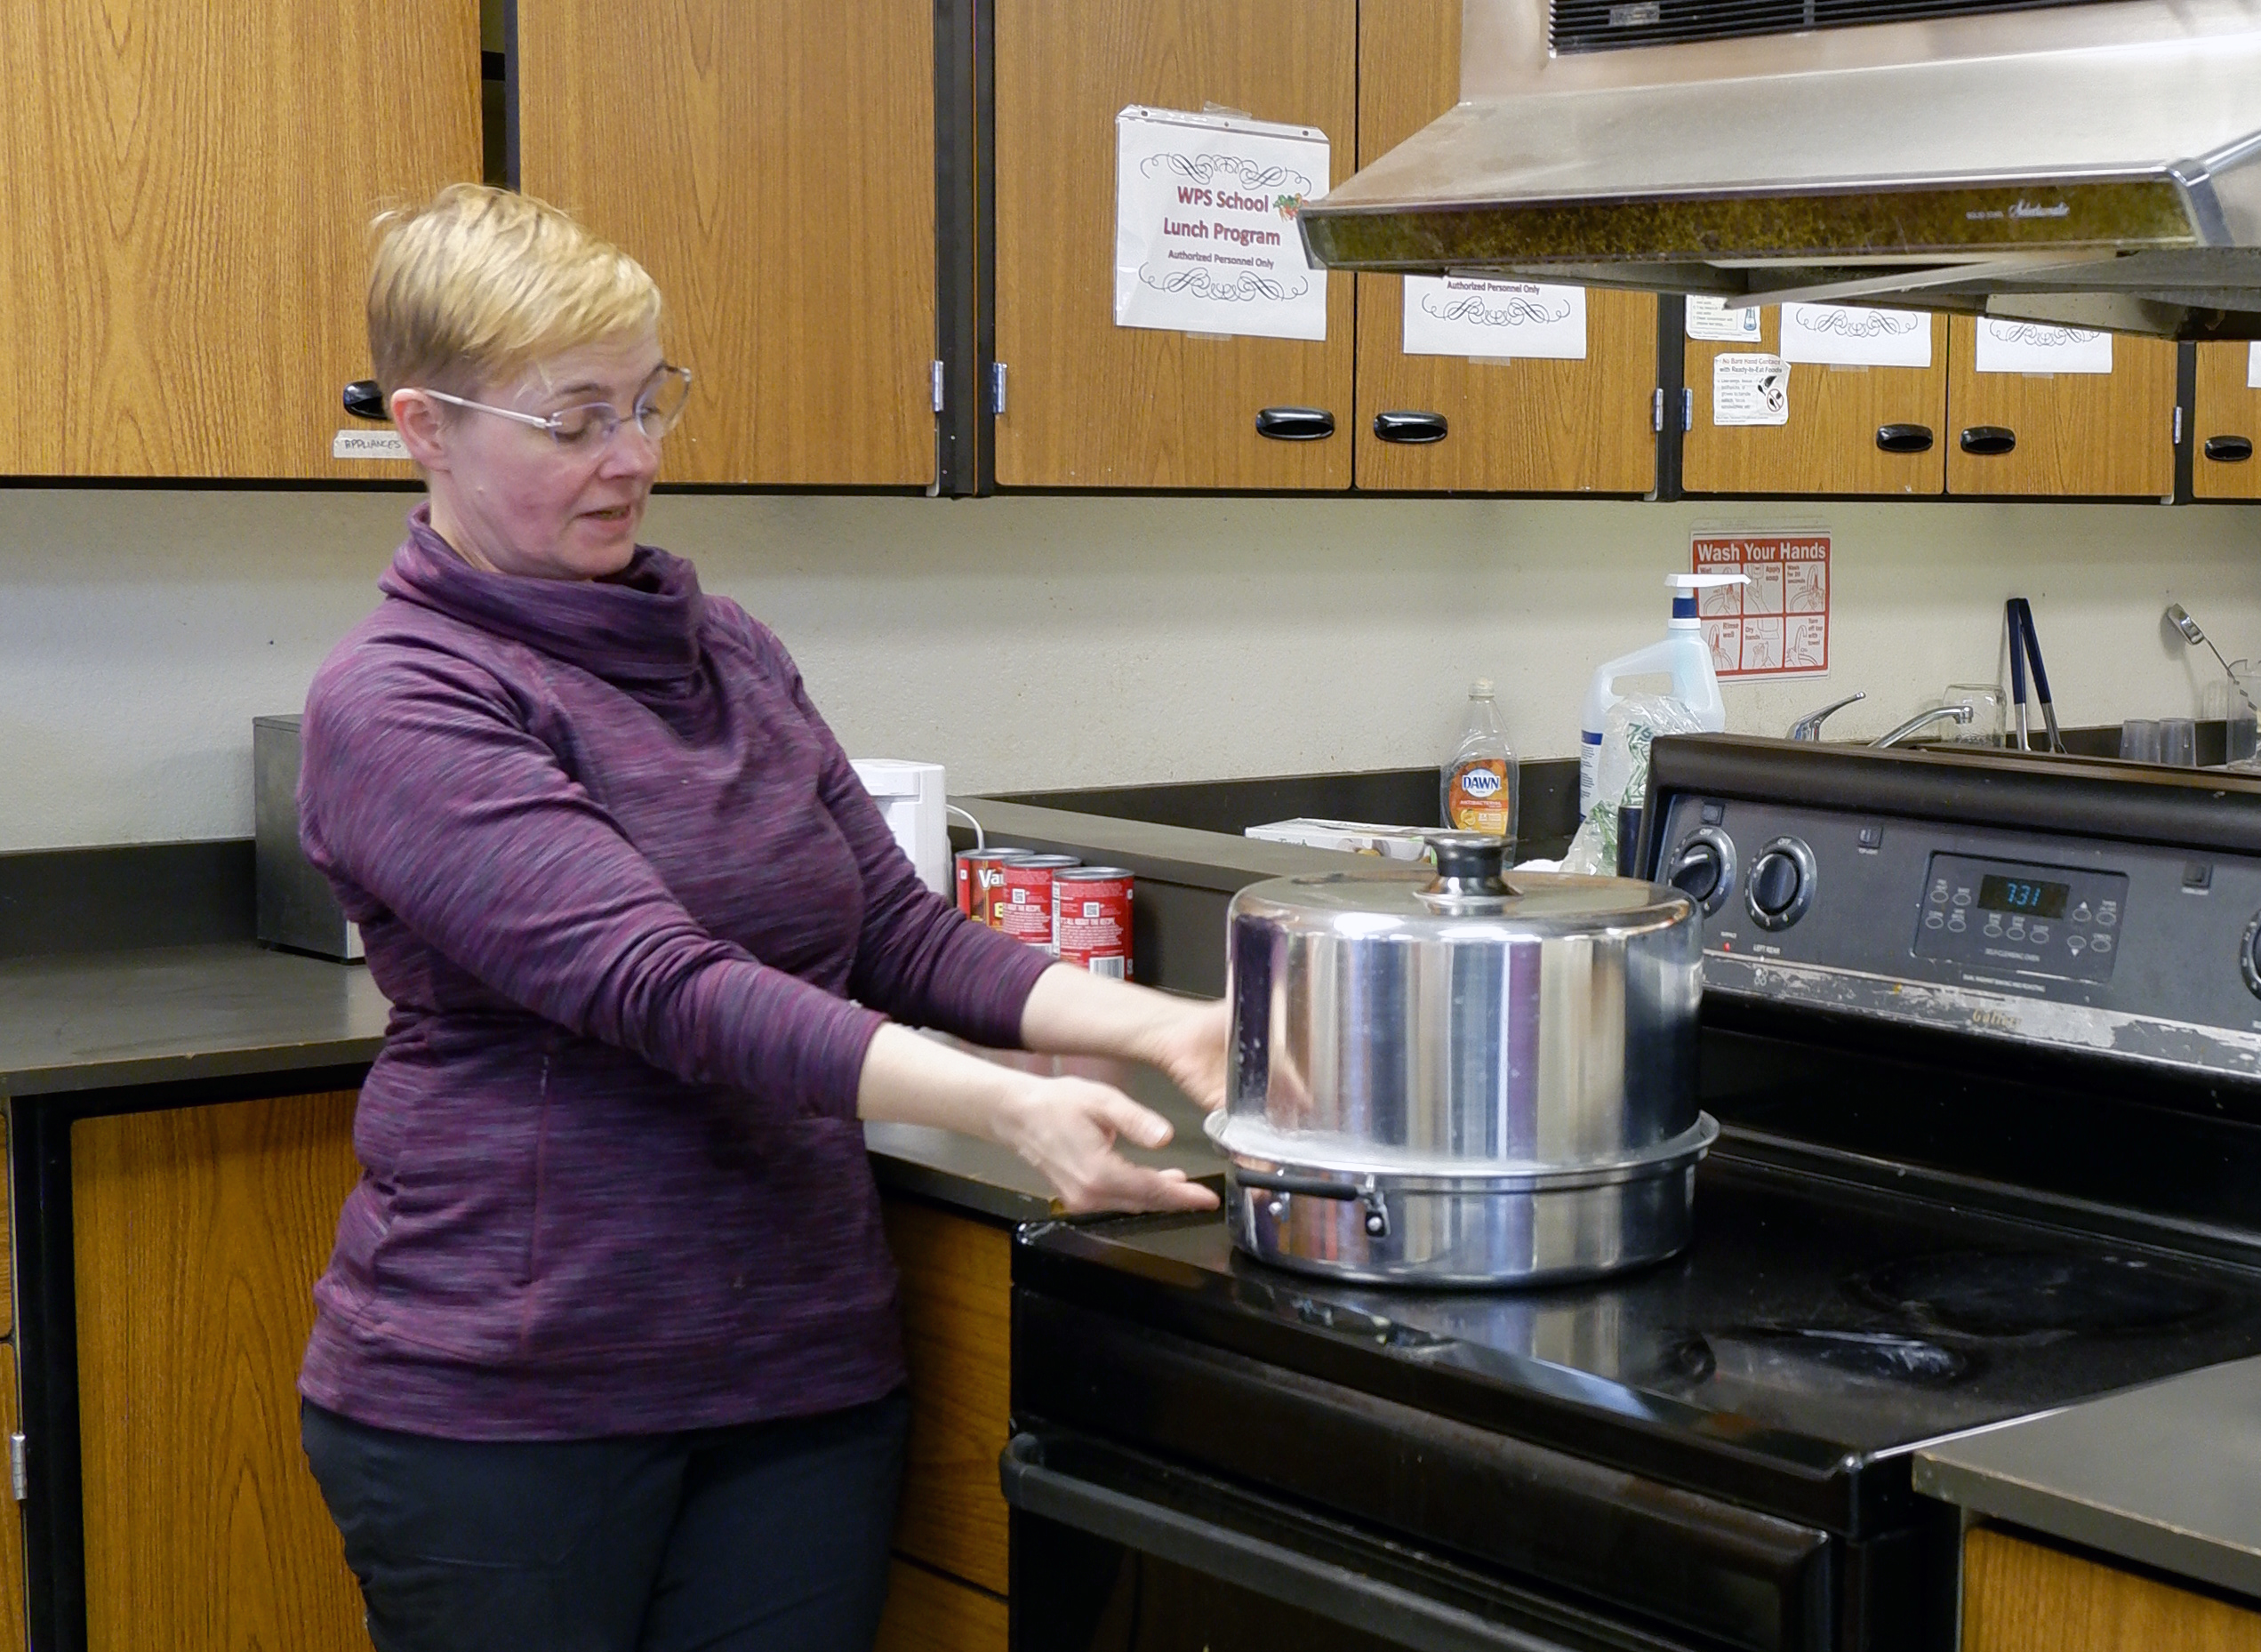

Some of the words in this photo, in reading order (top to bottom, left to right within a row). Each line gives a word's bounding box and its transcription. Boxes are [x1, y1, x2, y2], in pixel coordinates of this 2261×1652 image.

[1177, 186, 1213, 206] WPS
[1216, 191, 1269, 213] School
[1163, 217, 1208, 239] Lunch
[1214, 223, 1280, 246] Program
[1168, 250, 1212, 262] Authorized
[1215, 254, 1254, 267] Personnel
[1255, 258, 1274, 269] Only
[1447, 281, 1486, 291] Authorized
[1487, 283, 1522, 293] Personnel
[1523, 285, 1540, 295] Only
[344, 439, 402, 449] APPLIANCES
[1697, 543, 1740, 561] Wash
[1744, 542, 1776, 560] Your
[1780, 542, 1826, 559] Hands
[1463, 776, 1500, 790] DAWN
[1777, 838, 1792, 846] OFF
[2007, 882, 2041, 907] 731
[1753, 943, 1766, 952] LEFT
